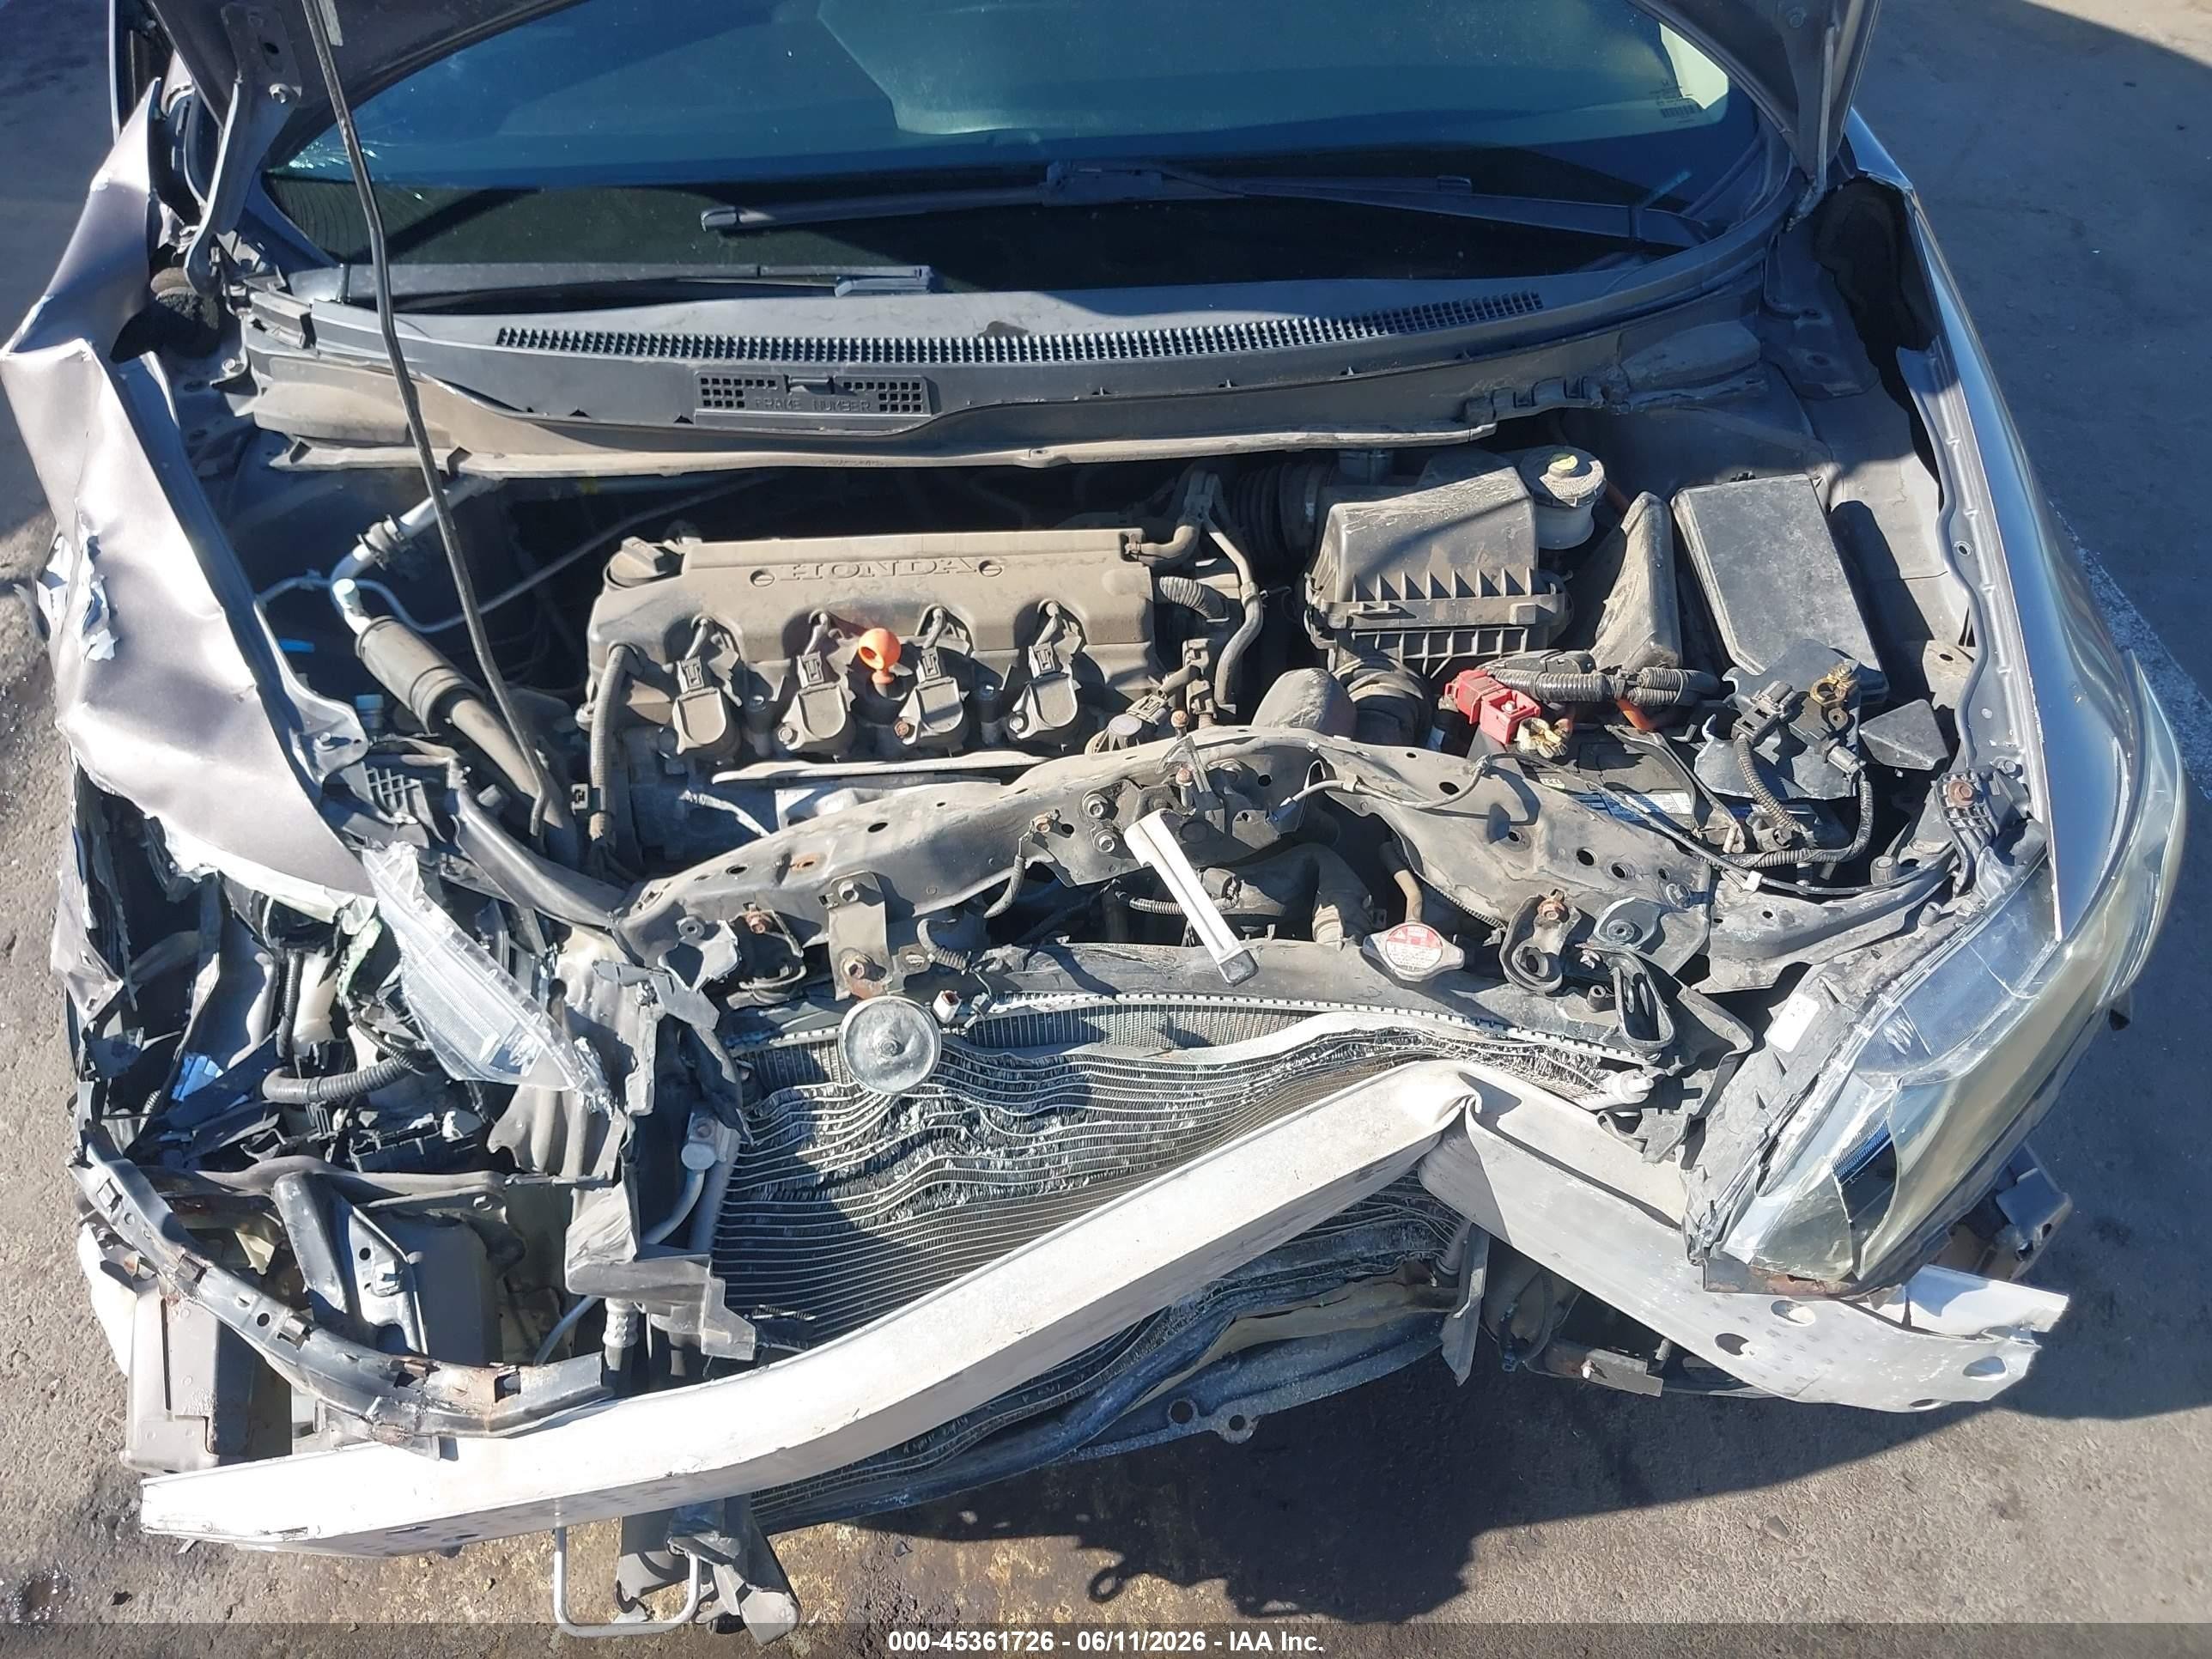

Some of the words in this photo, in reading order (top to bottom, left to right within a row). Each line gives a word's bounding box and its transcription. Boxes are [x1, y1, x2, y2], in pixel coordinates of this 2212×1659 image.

[755, 398, 802, 410] FRAME
[812, 398, 871, 412] NUMBER
[780, 557, 977, 581] HONDA
